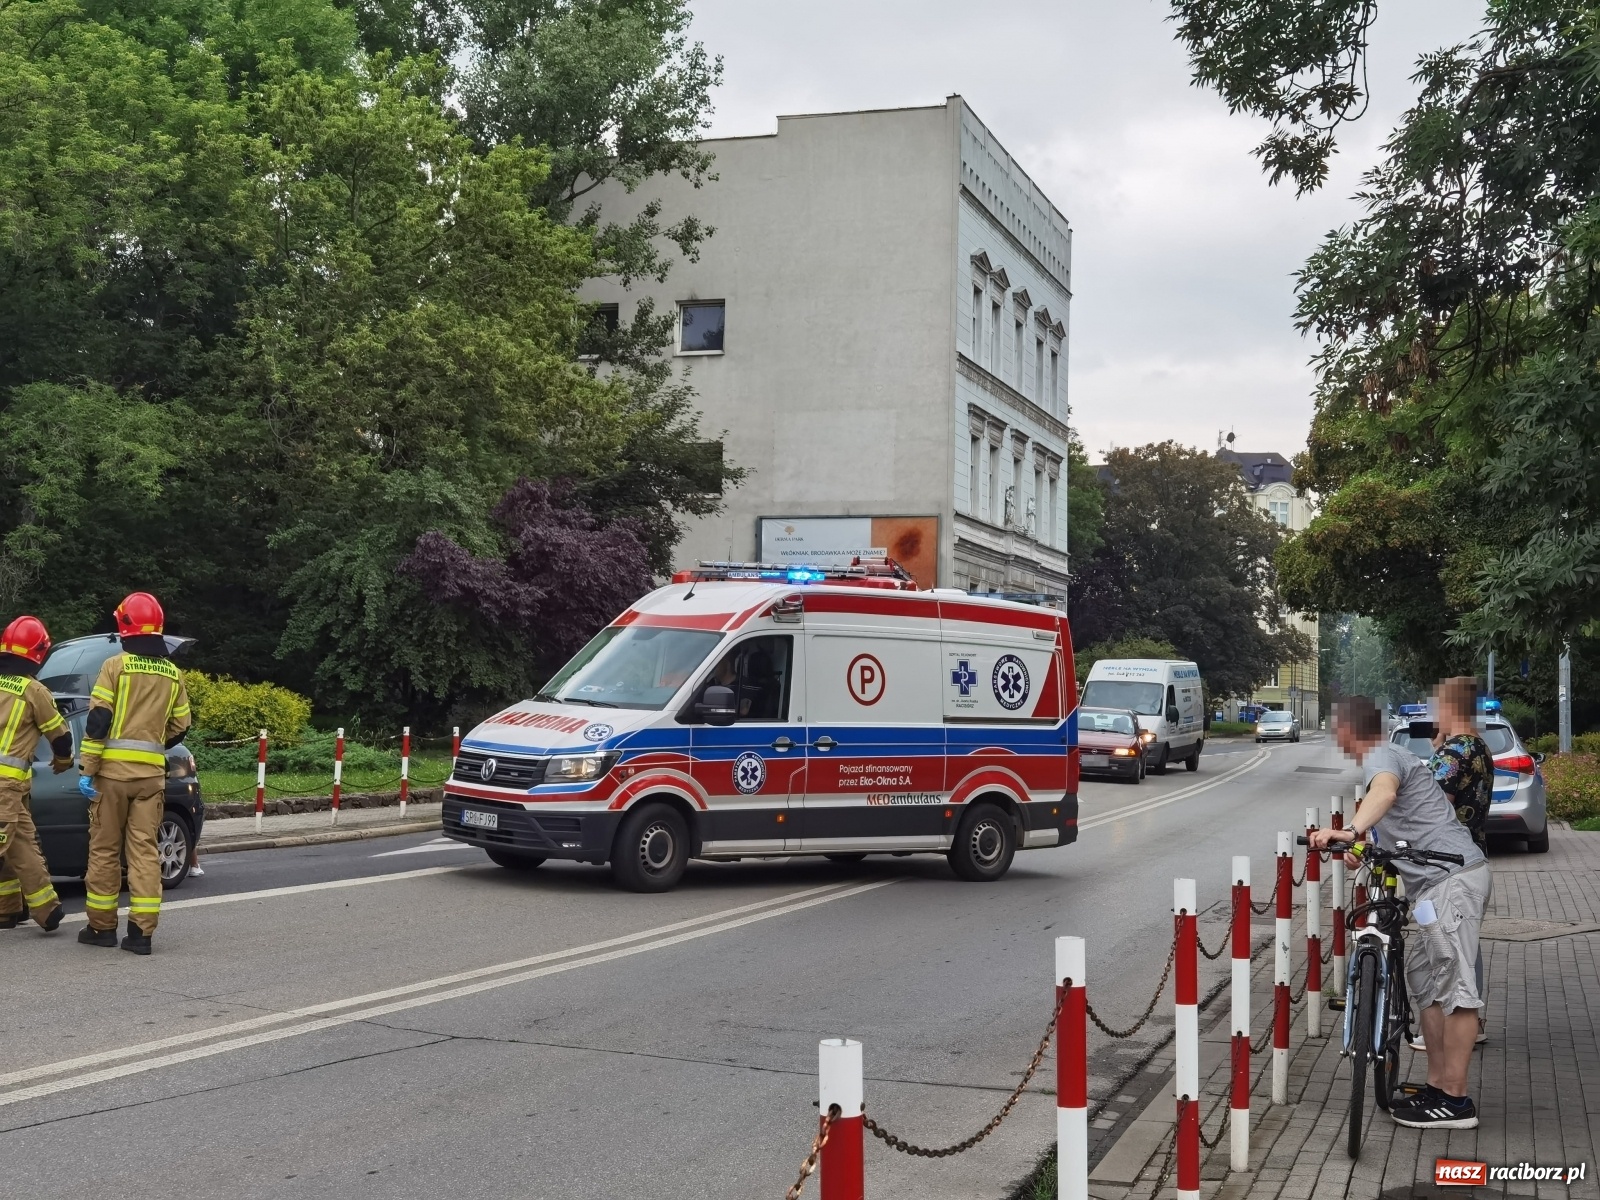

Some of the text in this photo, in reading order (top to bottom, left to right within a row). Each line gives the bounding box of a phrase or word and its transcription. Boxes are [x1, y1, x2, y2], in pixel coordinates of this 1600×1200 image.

[860, 666, 874, 694] P
[840, 764, 913, 774] Pojazd sfinansowany
[838, 776, 912, 788] przez Eko-Okna S.A.
